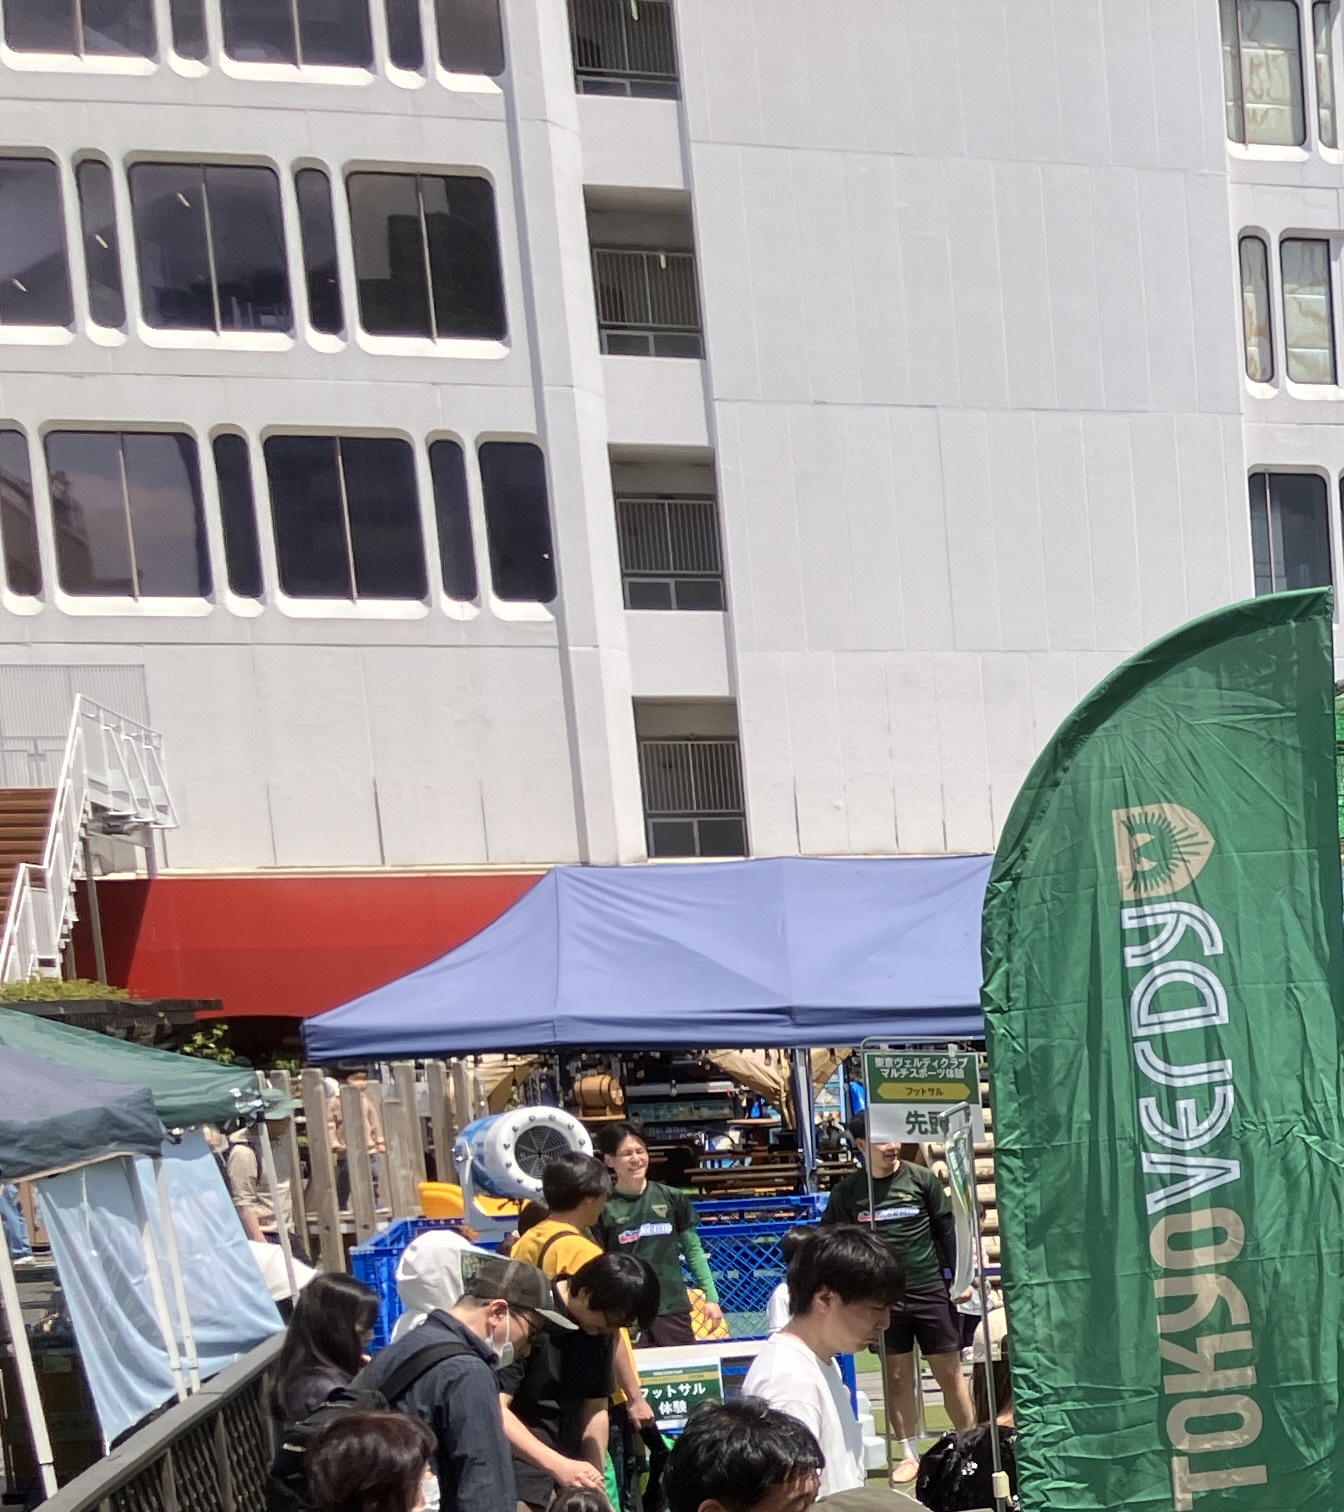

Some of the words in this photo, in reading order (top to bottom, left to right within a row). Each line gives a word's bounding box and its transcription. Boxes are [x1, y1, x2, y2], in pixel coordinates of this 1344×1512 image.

[875, 1057, 969, 1068] 東京ヴェルディクラブ
[1122, 901, 1241, 1215] VERDY
[880, 1068, 965, 1079] マルチスポーツ体験
[905, 1087, 944, 1097] フットサル
[1150, 1207, 1268, 1512] TOKYO
[640, 1383, 706, 1399] フットサル
[658, 1400, 688, 1415] 体験
